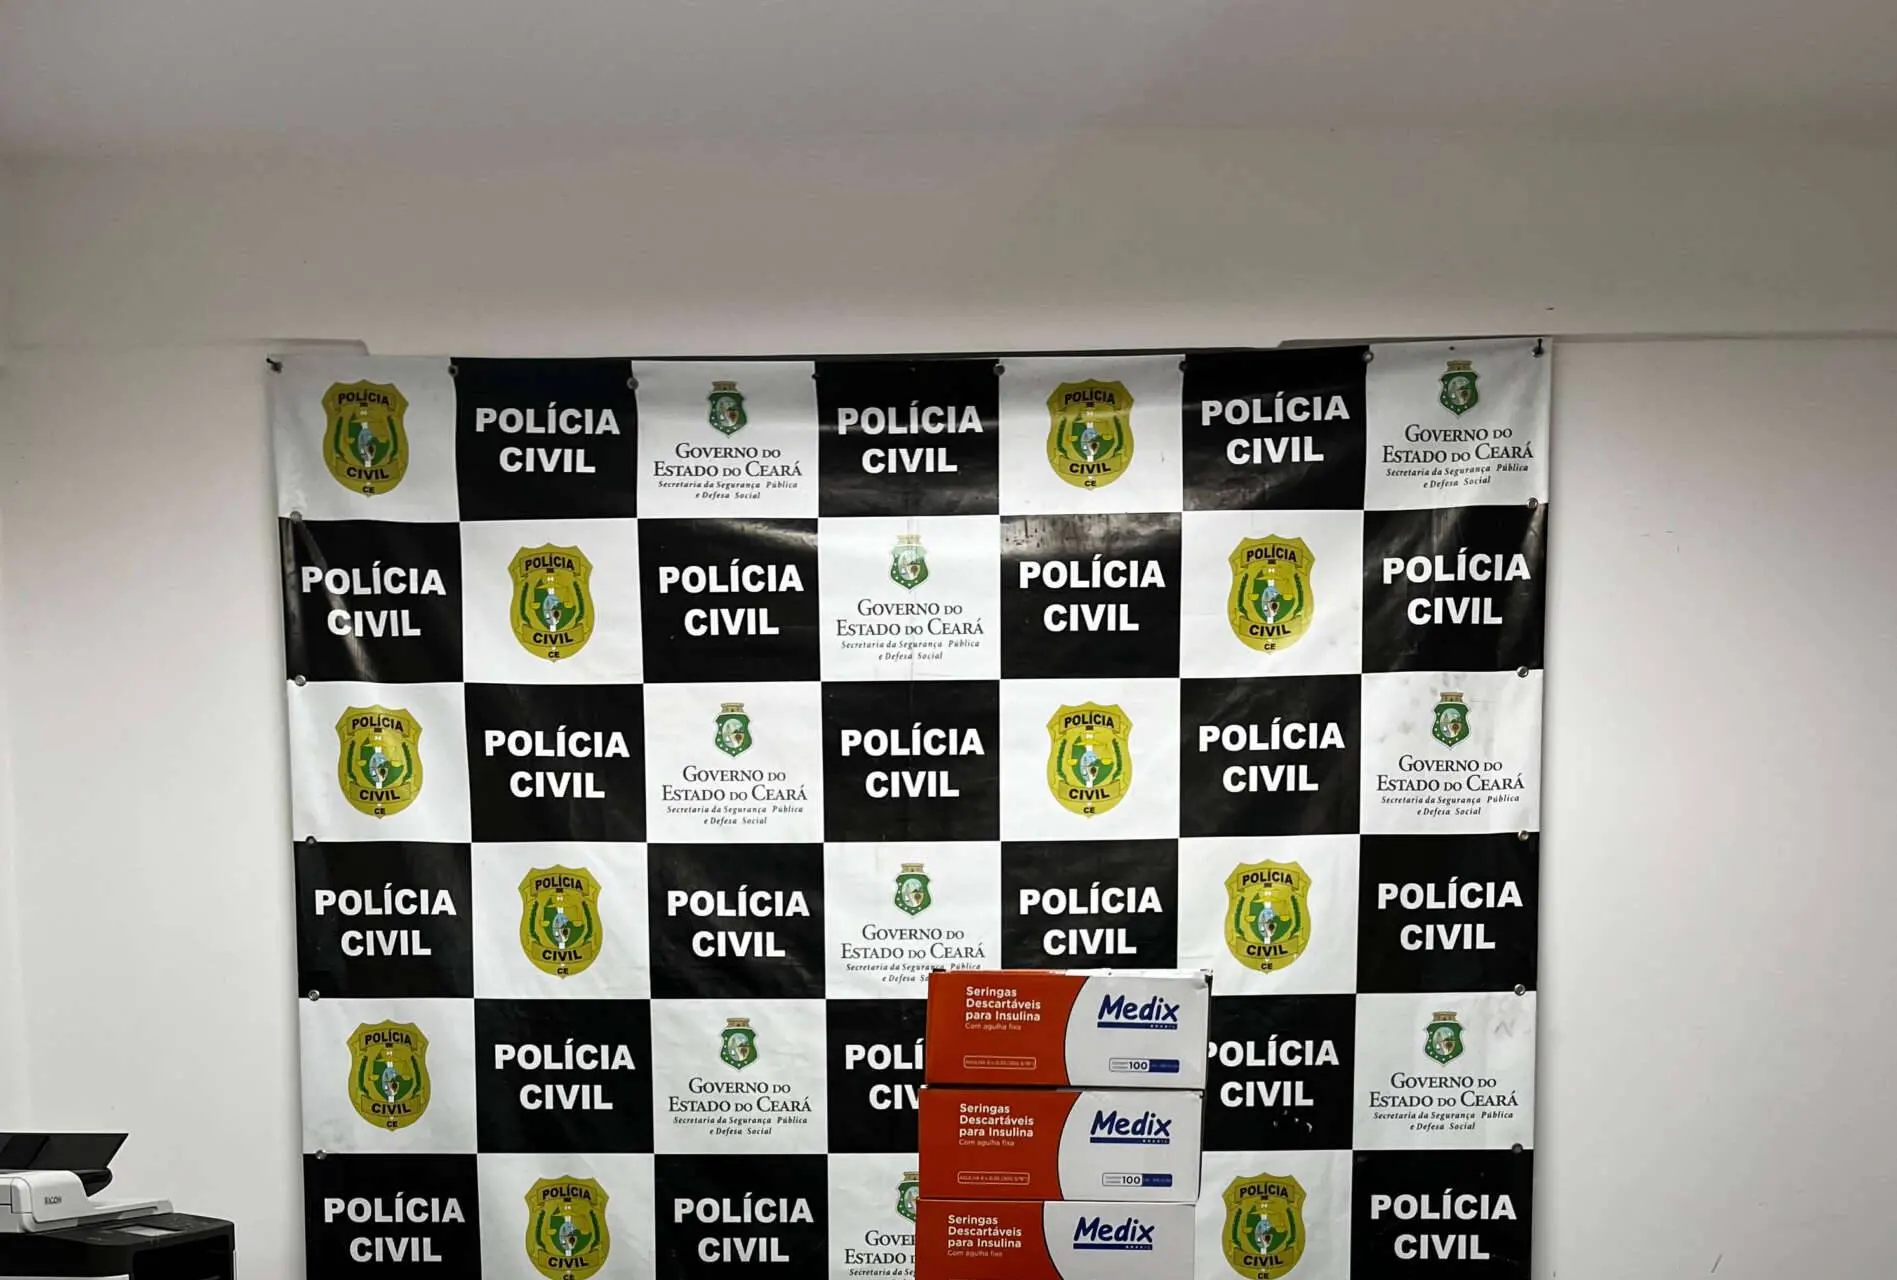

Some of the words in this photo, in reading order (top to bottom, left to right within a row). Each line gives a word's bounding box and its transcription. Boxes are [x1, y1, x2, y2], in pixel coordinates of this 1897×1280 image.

[476, 402, 620, 434] POLÍCIA
[838, 401, 983, 434] POLÍCIA
[1202, 396, 1350, 425] POLÍCIA
[500, 447, 595, 473] CIVIL
[862, 448, 957, 473] CIVIL
[1227, 436, 1324, 464] CIVIL
[345, 467, 389, 481] CIVIL
[302, 561, 446, 595] POLÍCIA
[659, 559, 804, 593] POLÍCIA
[1020, 554, 1165, 588] POLÍCIA
[1384, 547, 1531, 584] POLÍCIA
[327, 609, 421, 637] CIVIL
[685, 608, 779, 636] CIVIL
[1044, 604, 1139, 631] CIVIL
[1408, 597, 1502, 625] CIVIL
[1248, 623, 1292, 638] CIVIL
[485, 725, 630, 757] POLÍCIA
[842, 723, 984, 756] POLÍCIA
[1200, 717, 1345, 751] POLÍCIA
[510, 771, 605, 798] CIVIL
[866, 771, 959, 798] CIVIL
[1223, 765, 1318, 792] CIVIL
[1381, 796, 1423, 804] Secretaria
[1425, 796, 1435, 804] da
[1437, 796, 1481, 806] Segurança
[1487, 795, 1520, 803] Pública
[1423, 807, 1450, 817] Defesa
[1455, 807, 1481, 815] Social
[315, 883, 456, 915] POLÍCIA
[668, 885, 809, 917] POLÍCIA
[1020, 882, 1162, 914] POLÍCIA
[1378, 877, 1523, 909] POLÍCIA
[341, 930, 431, 956] CIVIL
[693, 931, 785, 957] CIVIL
[1044, 929, 1136, 955] CIVIL
[1401, 924, 1495, 950] CIVIL
[966, 986, 1017, 998] Seringas
[966, 998, 1041, 1010] Descartáveis
[966, 1012, 991, 1022] para
[995, 1010, 1041, 1022] Insulina
[1097, 994, 1180, 1022] Medix
[495, 1039, 635, 1069] POLÍCIA
[845, 1038, 924, 1070] POLÍ
[1128, 1061, 1148, 1071] 100
[520, 1084, 613, 1109] CIVIL
[1221, 1081, 1313, 1107] CIVIL
[673, 1116, 715, 1124] Secretaria
[717, 1116, 727, 1124] da
[729, 1116, 772, 1126] Segurança
[777, 1116, 808, 1124] Pública
[960, 1104, 1010, 1115] Seringas
[960, 1115, 1034, 1126] Descartáveis
[715, 1127, 742, 1136] Defesa
[747, 1127, 772, 1135] Social
[959, 1128, 985, 1138] para
[989, 1127, 1034, 1138] Insulina
[1090, 1110, 1172, 1137] Medix
[1122, 1175, 1141, 1185] 100
[324, 1192, 465, 1222] POLÍCIA
[675, 1192, 813, 1223] POLÍCIA
[1371, 1188, 1517, 1219] POLÍCIA
[948, 1215, 998, 1226] Seringas
[948, 1226, 1022, 1237] Descartáveis
[1073, 1216, 1155, 1242] Medix
[350, 1237, 441, 1262] CIVIL
[698, 1237, 789, 1262] CIVIL
[947, 1239, 974, 1248] para
[977, 1237, 1022, 1248] Insulina
[1394, 1234, 1489, 1259] CIVIL
